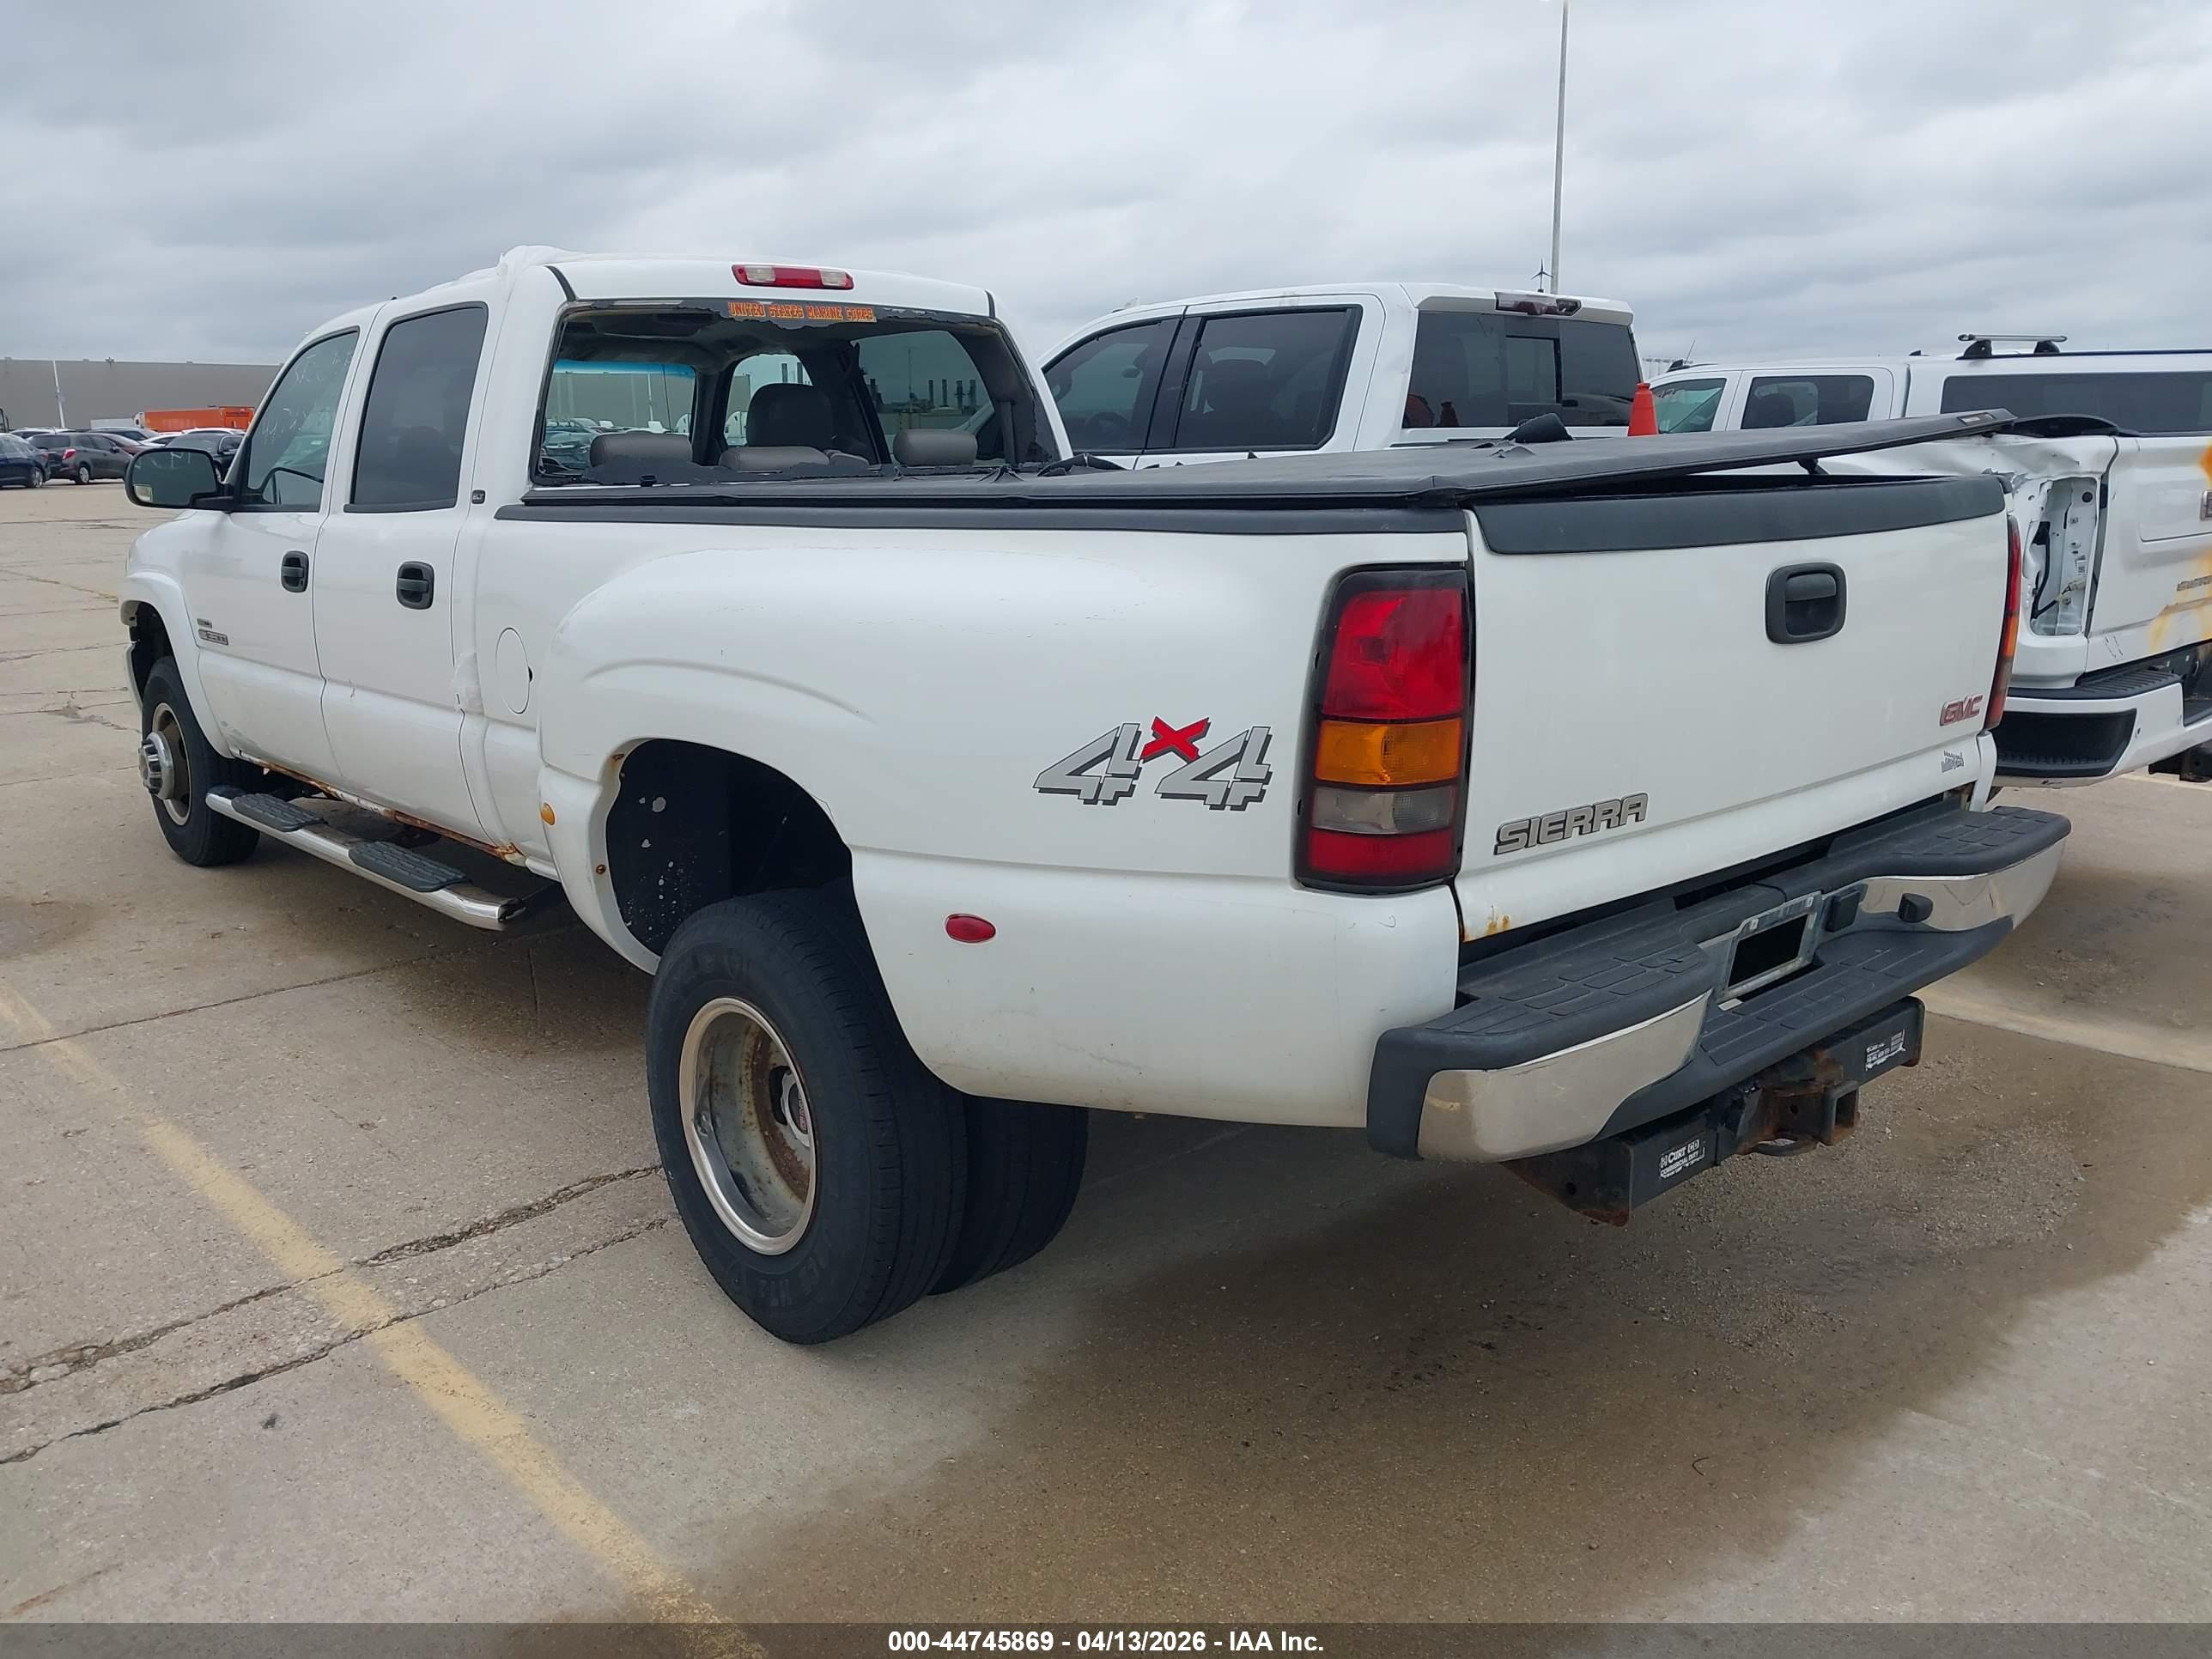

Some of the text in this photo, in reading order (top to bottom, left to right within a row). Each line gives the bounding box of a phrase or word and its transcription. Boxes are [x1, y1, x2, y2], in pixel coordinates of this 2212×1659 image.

[728, 302, 875, 322] UNITED STATES MARINE CORPS
[1940, 693, 1984, 726] GMC
[1493, 792, 1648, 855] SIERRA
